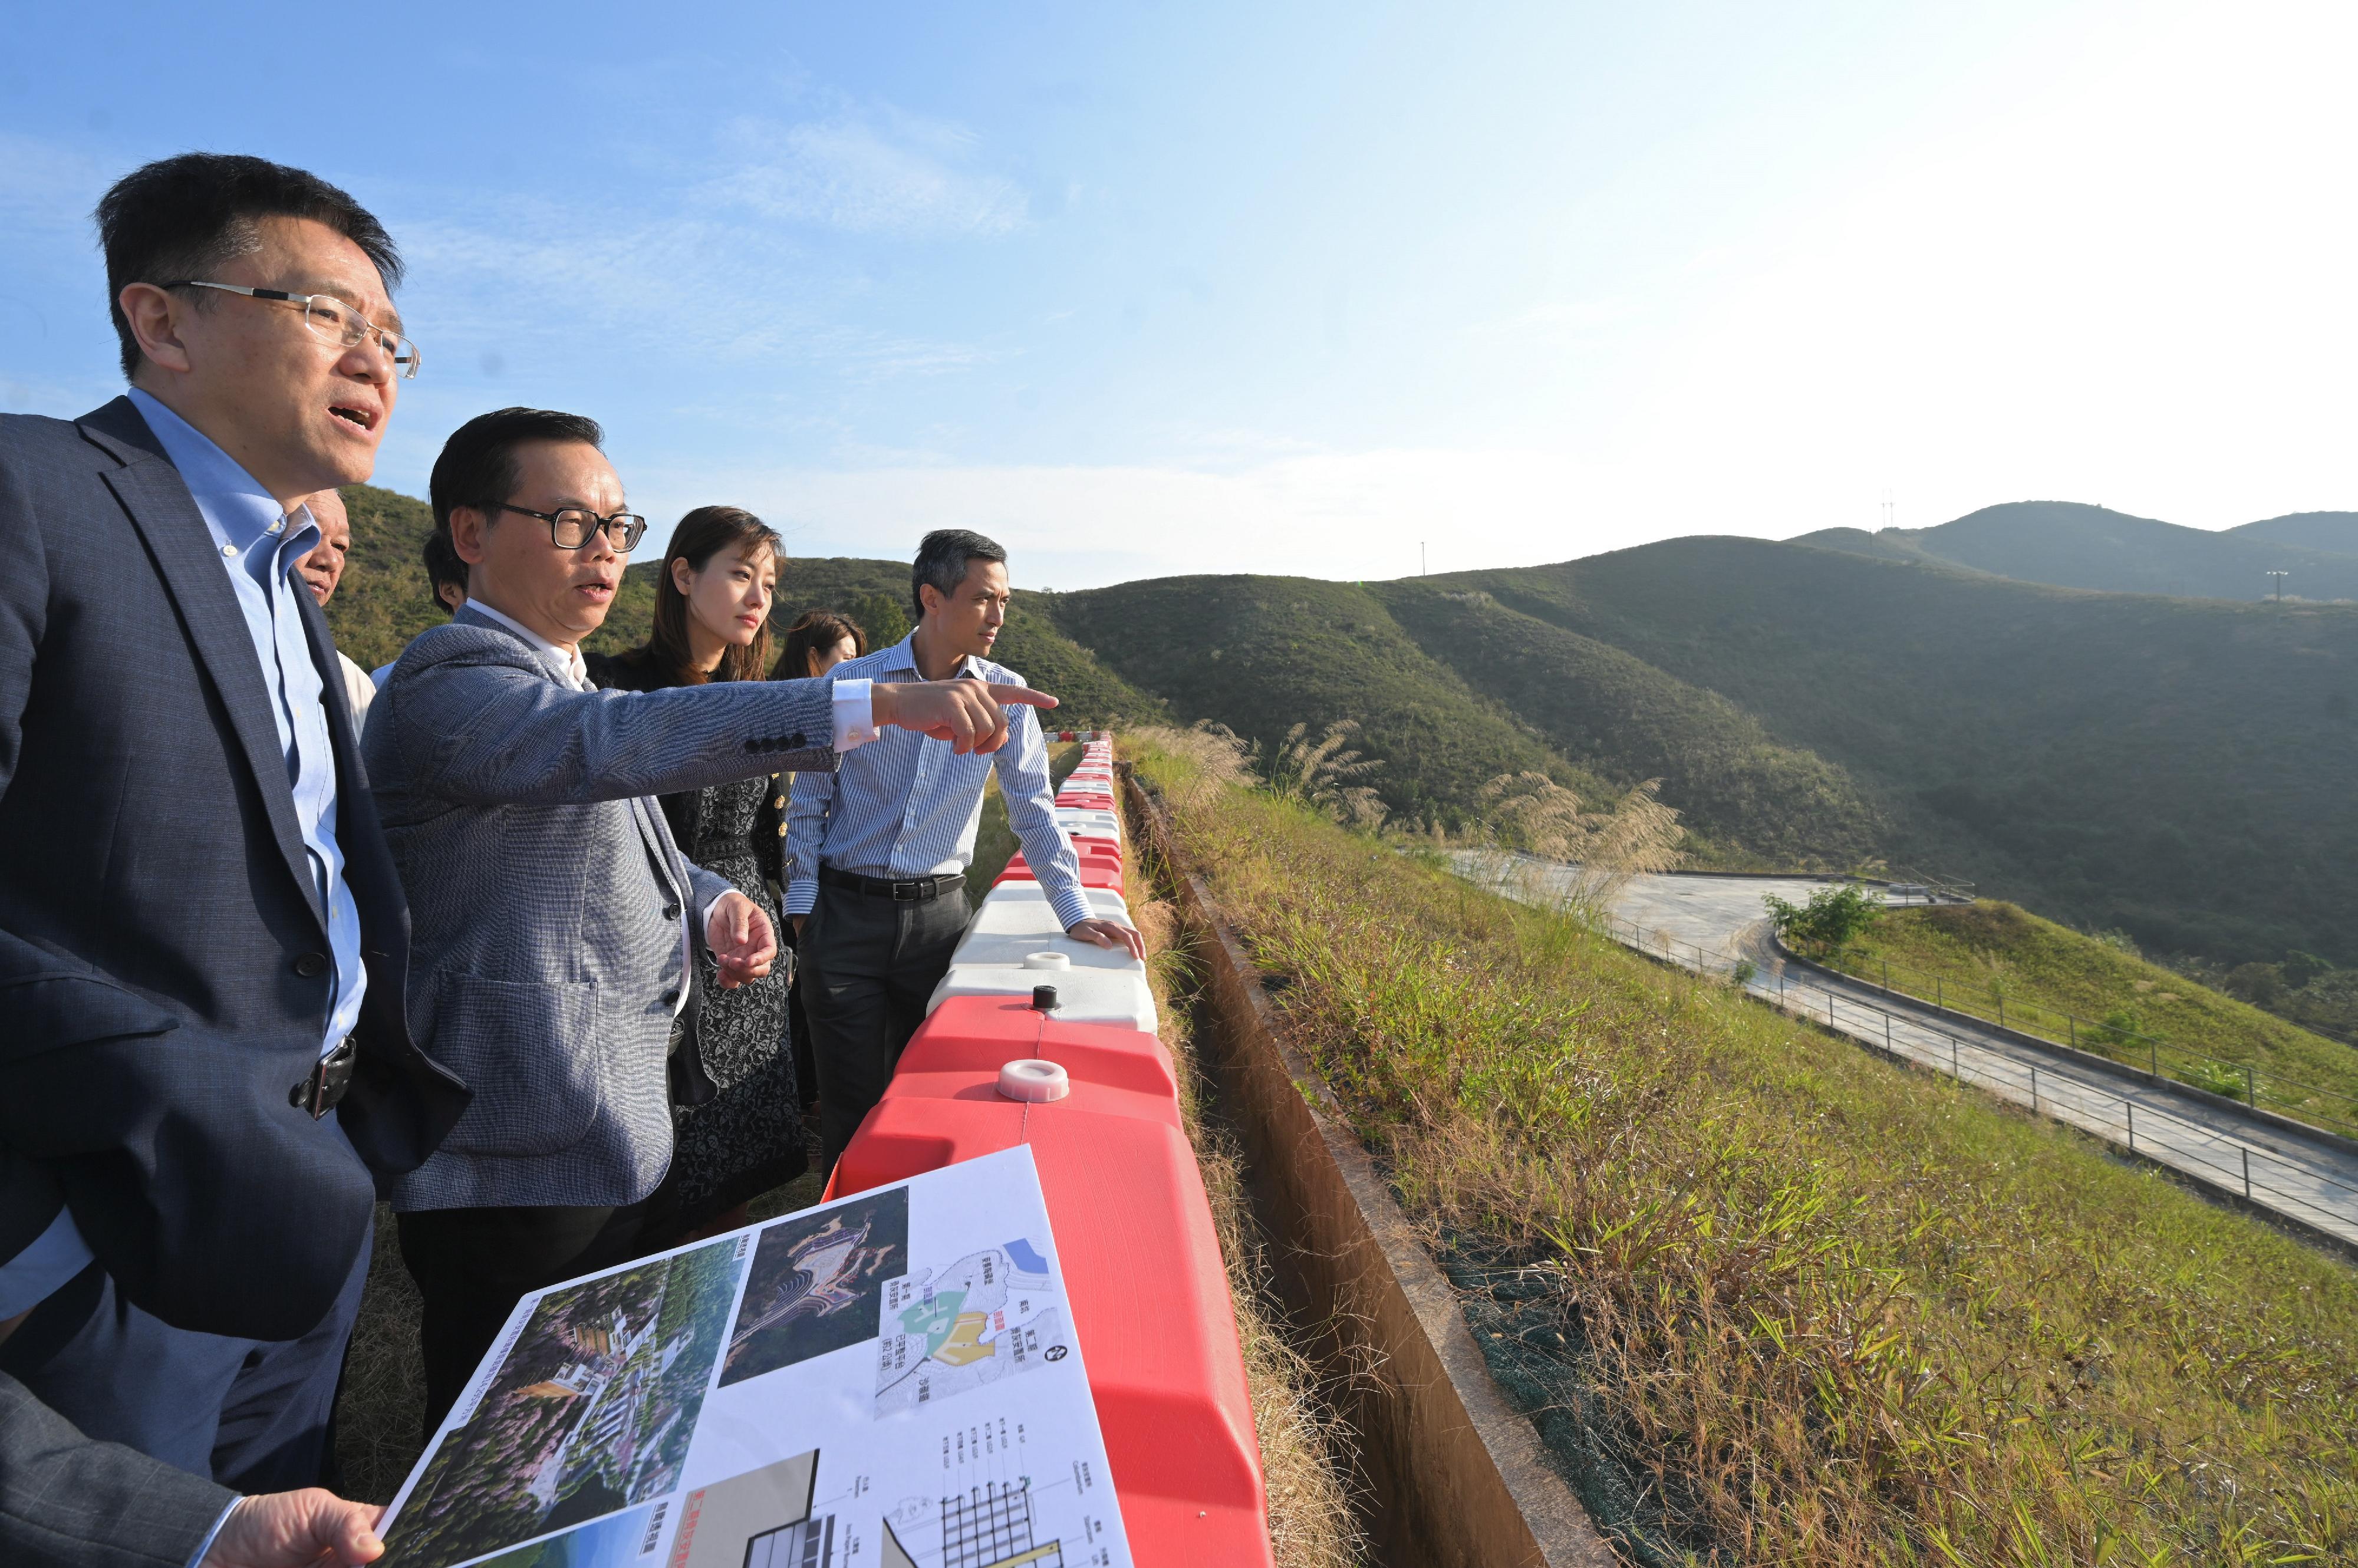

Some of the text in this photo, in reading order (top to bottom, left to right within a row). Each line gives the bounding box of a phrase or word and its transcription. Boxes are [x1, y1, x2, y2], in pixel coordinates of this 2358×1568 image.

[889, 1280, 899, 1310] 骨灰安置所
[895, 1333, 905, 1369] 已平整平台
[1010, 1326, 1026, 1363] 骨灰安置所
